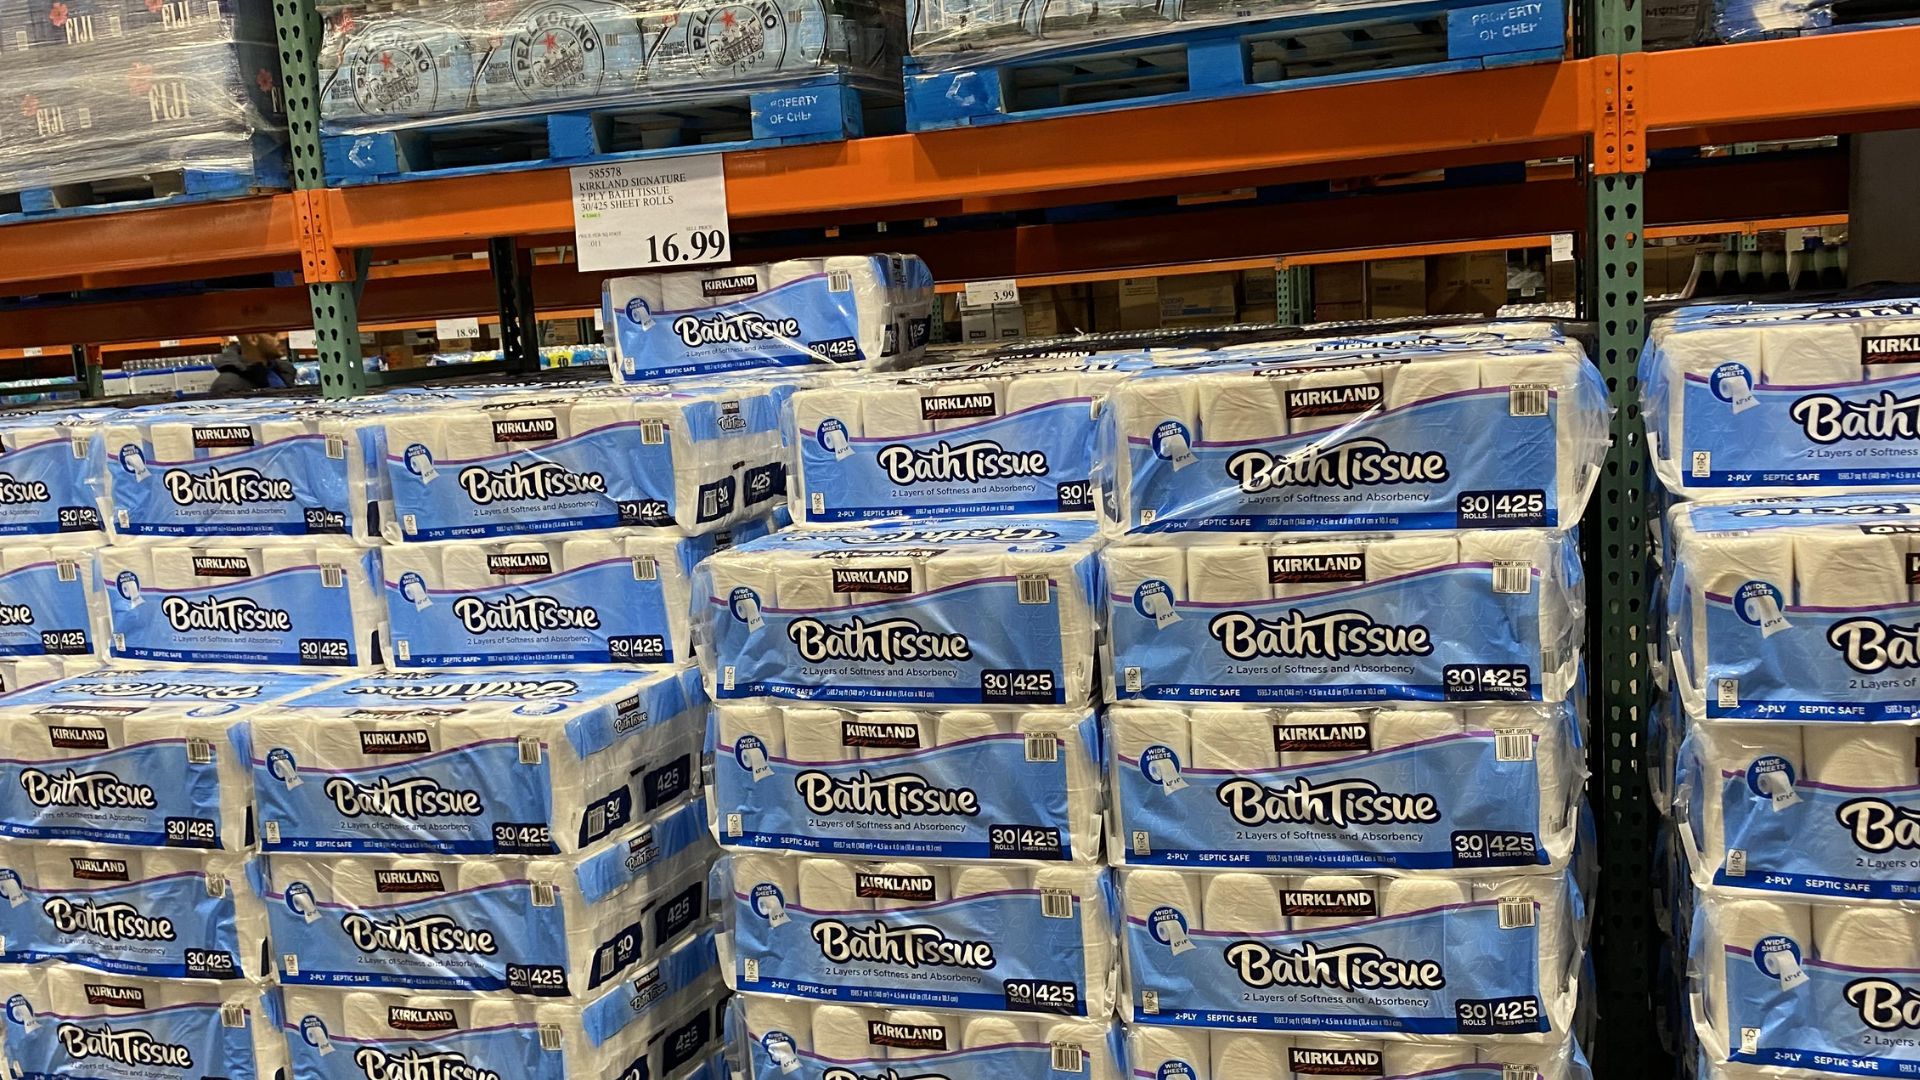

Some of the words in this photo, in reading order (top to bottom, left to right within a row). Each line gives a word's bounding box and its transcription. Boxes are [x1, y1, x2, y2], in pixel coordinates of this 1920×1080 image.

[161, 2, 192, 31] FIJI
[65, 16, 93, 45] FIJI
[150, 82, 192, 121] FIJI
[763, 95, 819, 110] OPERTY
[36, 107, 64, 135] FIJI
[589, 167, 621, 178] 585578
[579, 179, 628, 191] KIRKLAND
[632, 174, 686, 186] SIGNATURE
[580, 193, 585, 201] 2
[589, 191, 605, 201] PLY
[609, 188, 634, 199] BATH
[638, 186, 669, 196] TISSUE
[581, 201, 607, 211] 30/425
[610, 199, 639, 209] SHEET
[643, 196, 673, 206] ROLLS
[646, 230, 725, 263] 16.99
[705, 277, 754, 289] KIRKLAND
[993, 290, 1015, 302] 3.99
[456, 328, 479, 338] 18.99
[828, 341, 856, 354] 425
[1717, 369, 1745, 378] SHEETS
[1720, 365, 1740, 373] WIDE
[1290, 386, 1380, 406] KIRKLAND
[925, 397, 992, 410] KIRKLAND
[195, 428, 250, 439] KIRKLAND
[496, 420, 554, 434] KIRKLAND
[1807, 449, 1814, 458] 2
[1817, 449, 1851, 460] Layers
[1855, 448, 1867, 457] of
[1871, 448, 1918, 457] Softness
[1727, 474, 1752, 482] 2-PLY
[1061, 486, 1080, 499] 30
[1461, 496, 1489, 512] 30
[1496, 494, 1543, 512] 425
[195, 559, 246, 569] KIRKLAND
[490, 556, 548, 566] KIRKLAND
[1273, 557, 1361, 572] KIRKLAND
[837, 571, 909, 583] KIRKLAND
[1140, 586, 1165, 596] SHEETS
[1142, 582, 1160, 590] WIDE
[43, 634, 59, 645] 30
[62, 633, 84, 646] 425
[610, 639, 628, 652] 30
[633, 639, 663, 652] 425
[301, 642, 318, 655] 30
[321, 642, 348, 656] 425
[1236, 666, 1268, 675] Layers
[1285, 665, 1327, 673] Softness
[1331, 665, 1349, 673] and
[1353, 665, 1415, 674] Absorbency
[1447, 669, 1475, 685] 30
[1482, 668, 1527, 685] 425
[984, 674, 1008, 689] 30
[1014, 675, 1052, 690] 425
[1758, 705, 1786, 713] 2-PLY
[1799, 706, 1835, 714] SEPTIC
[1838, 706, 1865, 714] SAFE
[52, 729, 105, 741] KIRKLAND
[846, 724, 916, 739] KIRKLAND
[1279, 727, 1366, 740] KIRKLAND
[364, 733, 426, 745] KIRKLAND
[167, 821, 184, 833] 30
[190, 822, 214, 837] 425
[496, 826, 515, 840] 30
[519, 826, 550, 843] 425
[993, 829, 1015, 844] 30
[1021, 831, 1059, 846] 425
[1245, 832, 1277, 841] Layers
[1281, 831, 1290, 839] of
[1293, 831, 1336, 840] Softness
[1339, 832, 1358, 840] and
[1361, 832, 1423, 842] Absorbency
[1455, 836, 1482, 851] 30
[1489, 835, 1534, 851] 425
[75, 860, 125, 872] KIRKLAND
[379, 872, 439, 886] KIRKLAND
[860, 876, 932, 892] KIRKLAND
[1285, 893, 1371, 906] KIRKLAND
[668, 898, 689, 921] 425
[617, 936, 633, 955] 30
[207, 954, 231, 968] 425
[509, 967, 526, 981] 30
[531, 968, 563, 984] 425
[88, 986, 142, 999] KIRKLAND
[1007, 984, 1031, 999] 30
[1036, 984, 1075, 1002] 425
[392, 1009, 452, 1023] KIRKLAND
[1460, 1004, 1487, 1017] 30
[1494, 1001, 1538, 1020] 425
[1175, 1013, 1197, 1021] 2-PLY
[1206, 1014, 1233, 1023] SEPTIC
[1236, 1016, 1258, 1024] SAFE
[872, 1025, 943, 1041] KIRKLAND
[1293, 1050, 1379, 1066] KIRKLAND
[1774, 1052, 1801, 1062] 2-PLY
[1815, 1056, 1848, 1066] SEPTIC
[1852, 1059, 1878, 1069] SAFE
